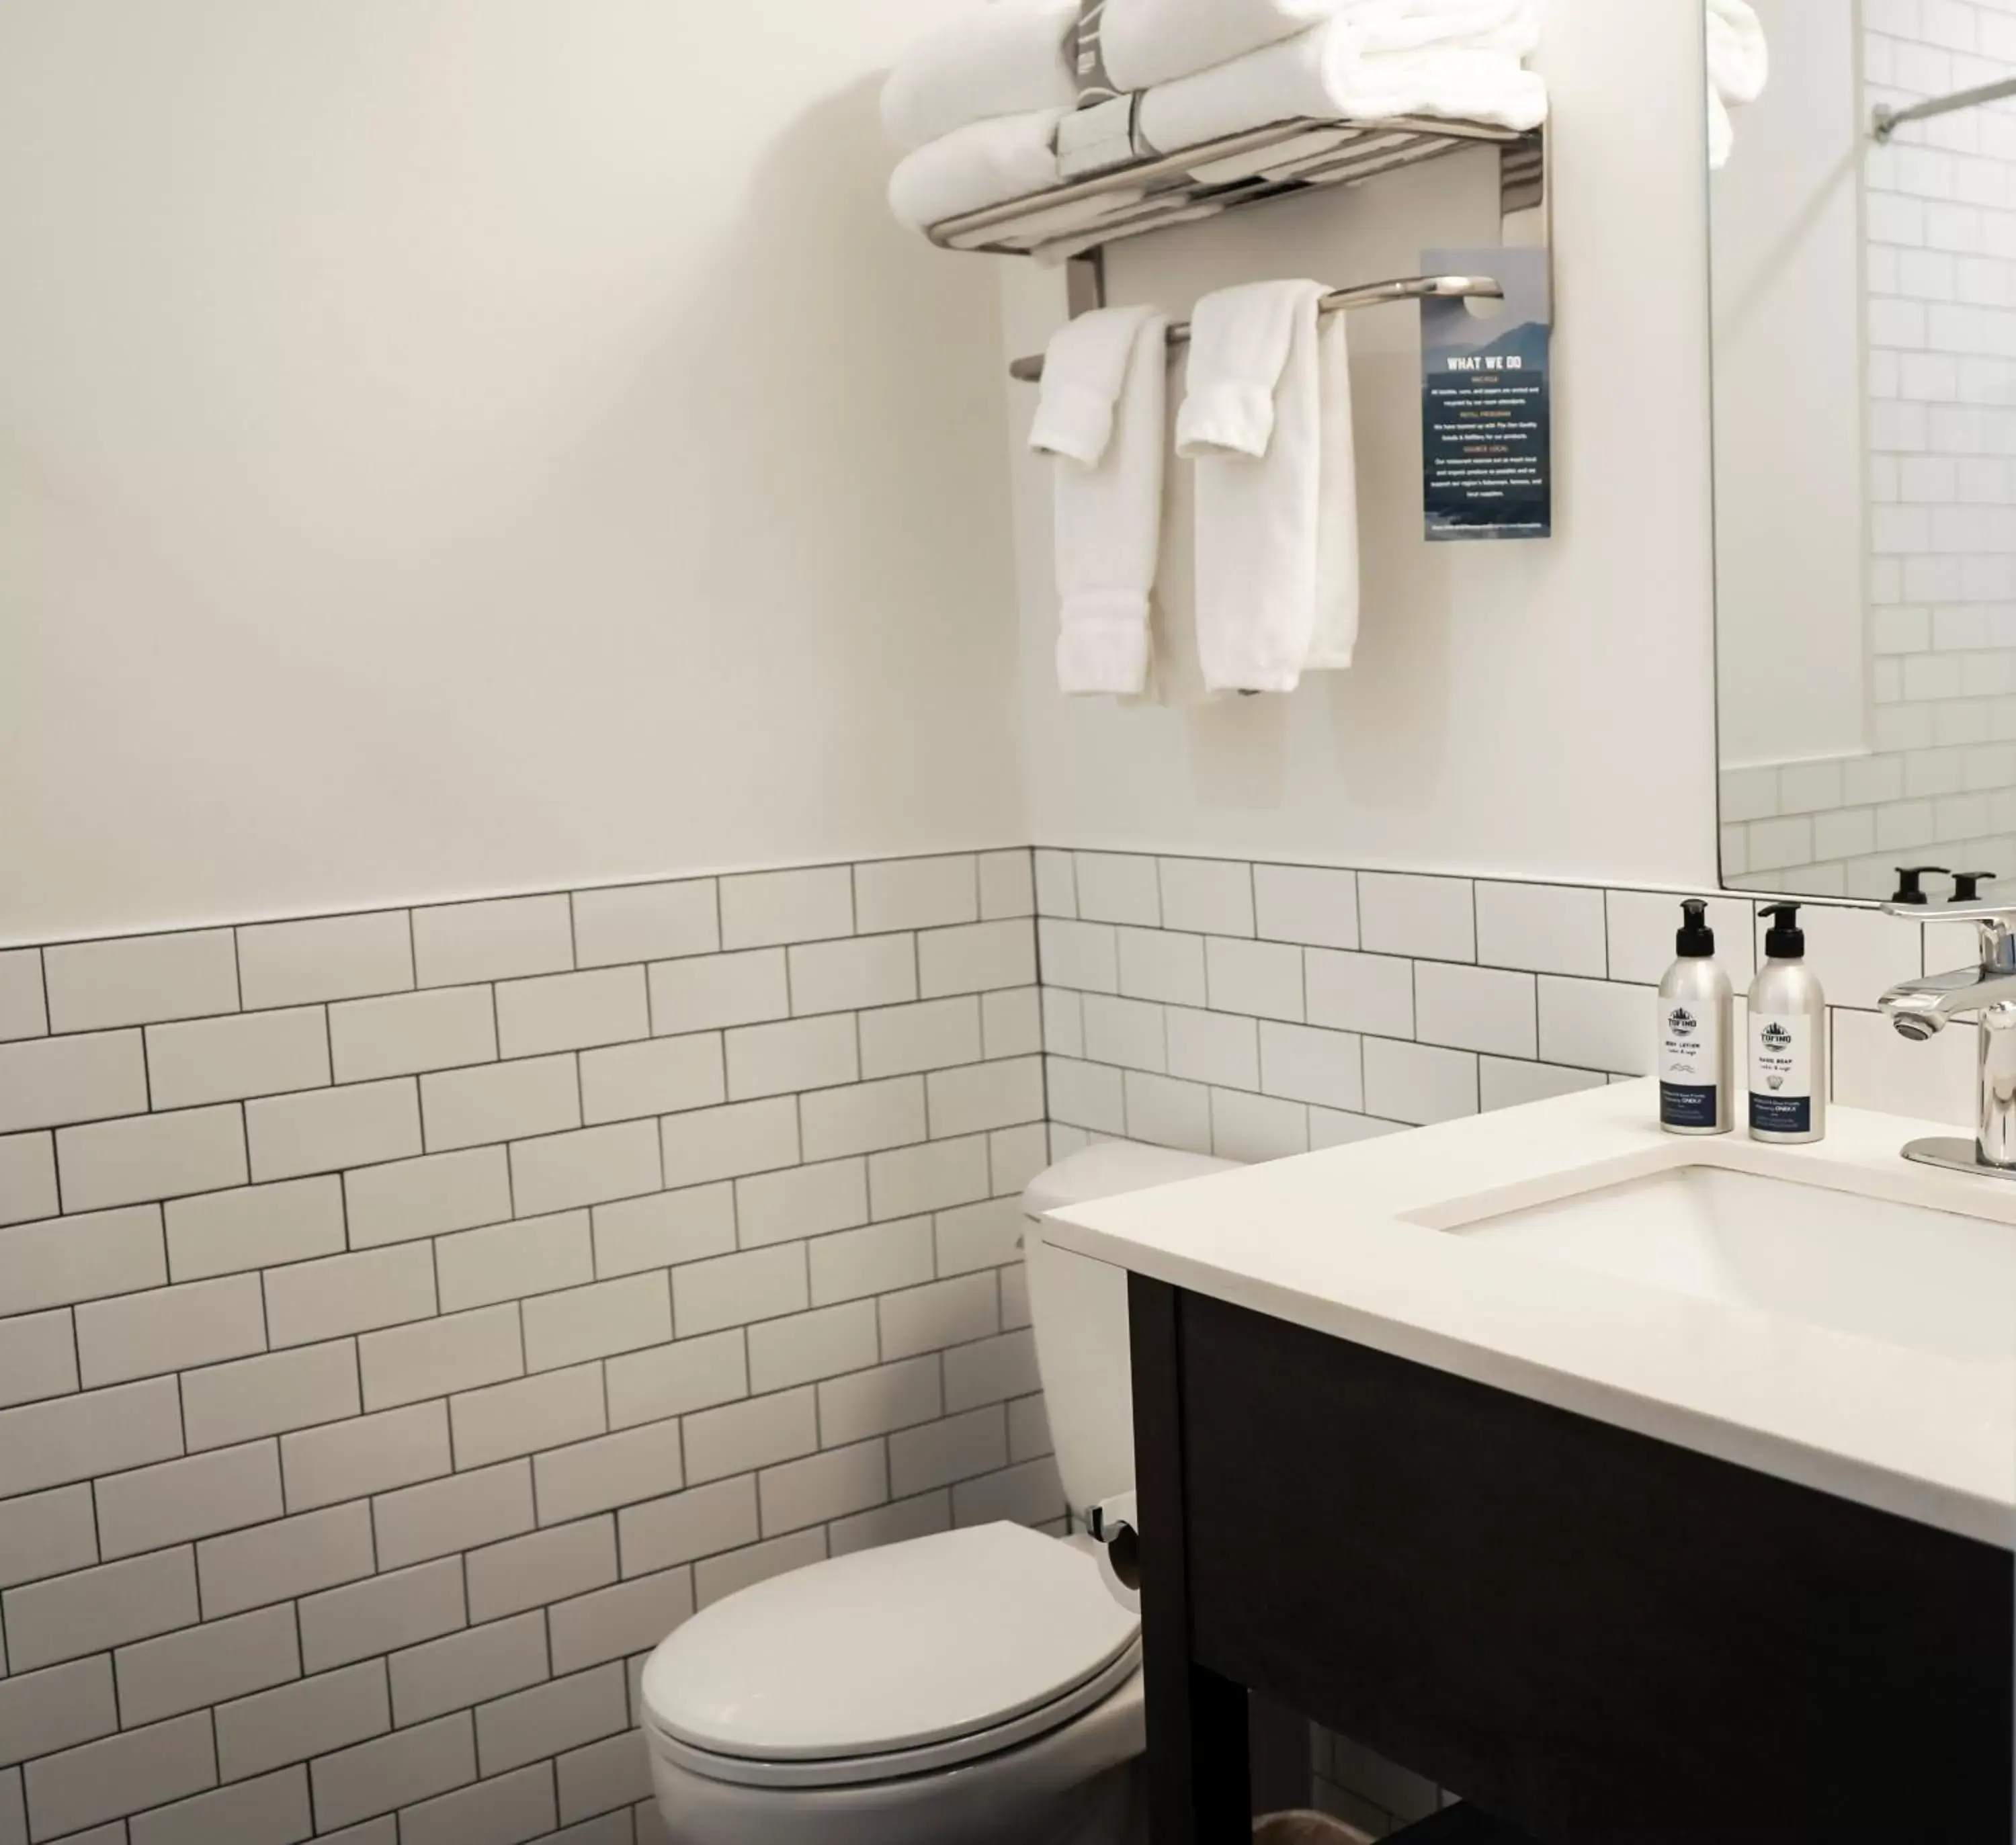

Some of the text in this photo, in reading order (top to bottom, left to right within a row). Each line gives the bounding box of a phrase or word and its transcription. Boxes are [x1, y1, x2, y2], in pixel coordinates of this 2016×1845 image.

[1447, 356, 1521, 370] WHAT WE DO
